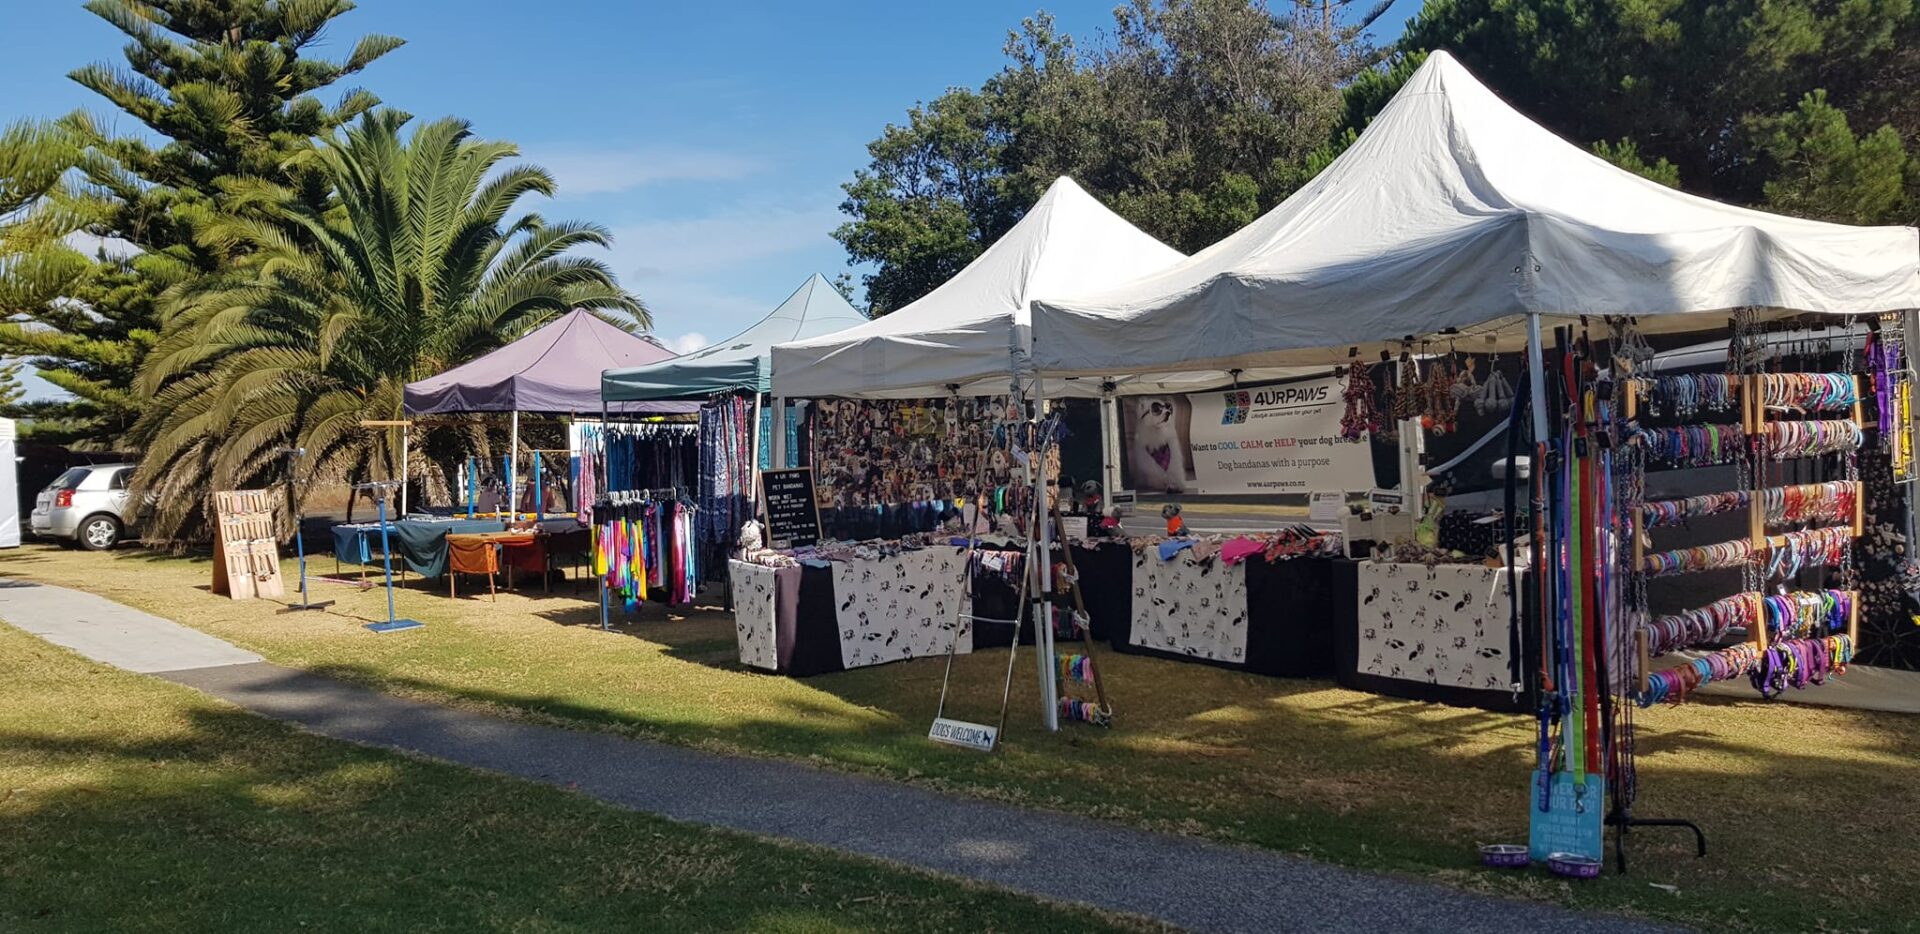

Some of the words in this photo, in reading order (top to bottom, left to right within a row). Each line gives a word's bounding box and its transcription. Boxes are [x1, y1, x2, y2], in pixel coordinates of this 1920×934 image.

[1301, 409, 1313, 417] your
[1210, 443, 1218, 451] to
[1240, 439, 1264, 450] CALM
[1274, 438, 1297, 448] HELP
[1297, 438, 1317, 448] your
[1318, 435, 1333, 446] dog
[1217, 460, 1233, 471] Dog
[1233, 459, 1270, 469] bandanas
[1270, 458, 1290, 468] with
[1291, 459, 1296, 467] a
[1297, 457, 1330, 469] purpose
[931, 722, 951, 738] DOGS
[950, 726, 983, 744] WELCOME
